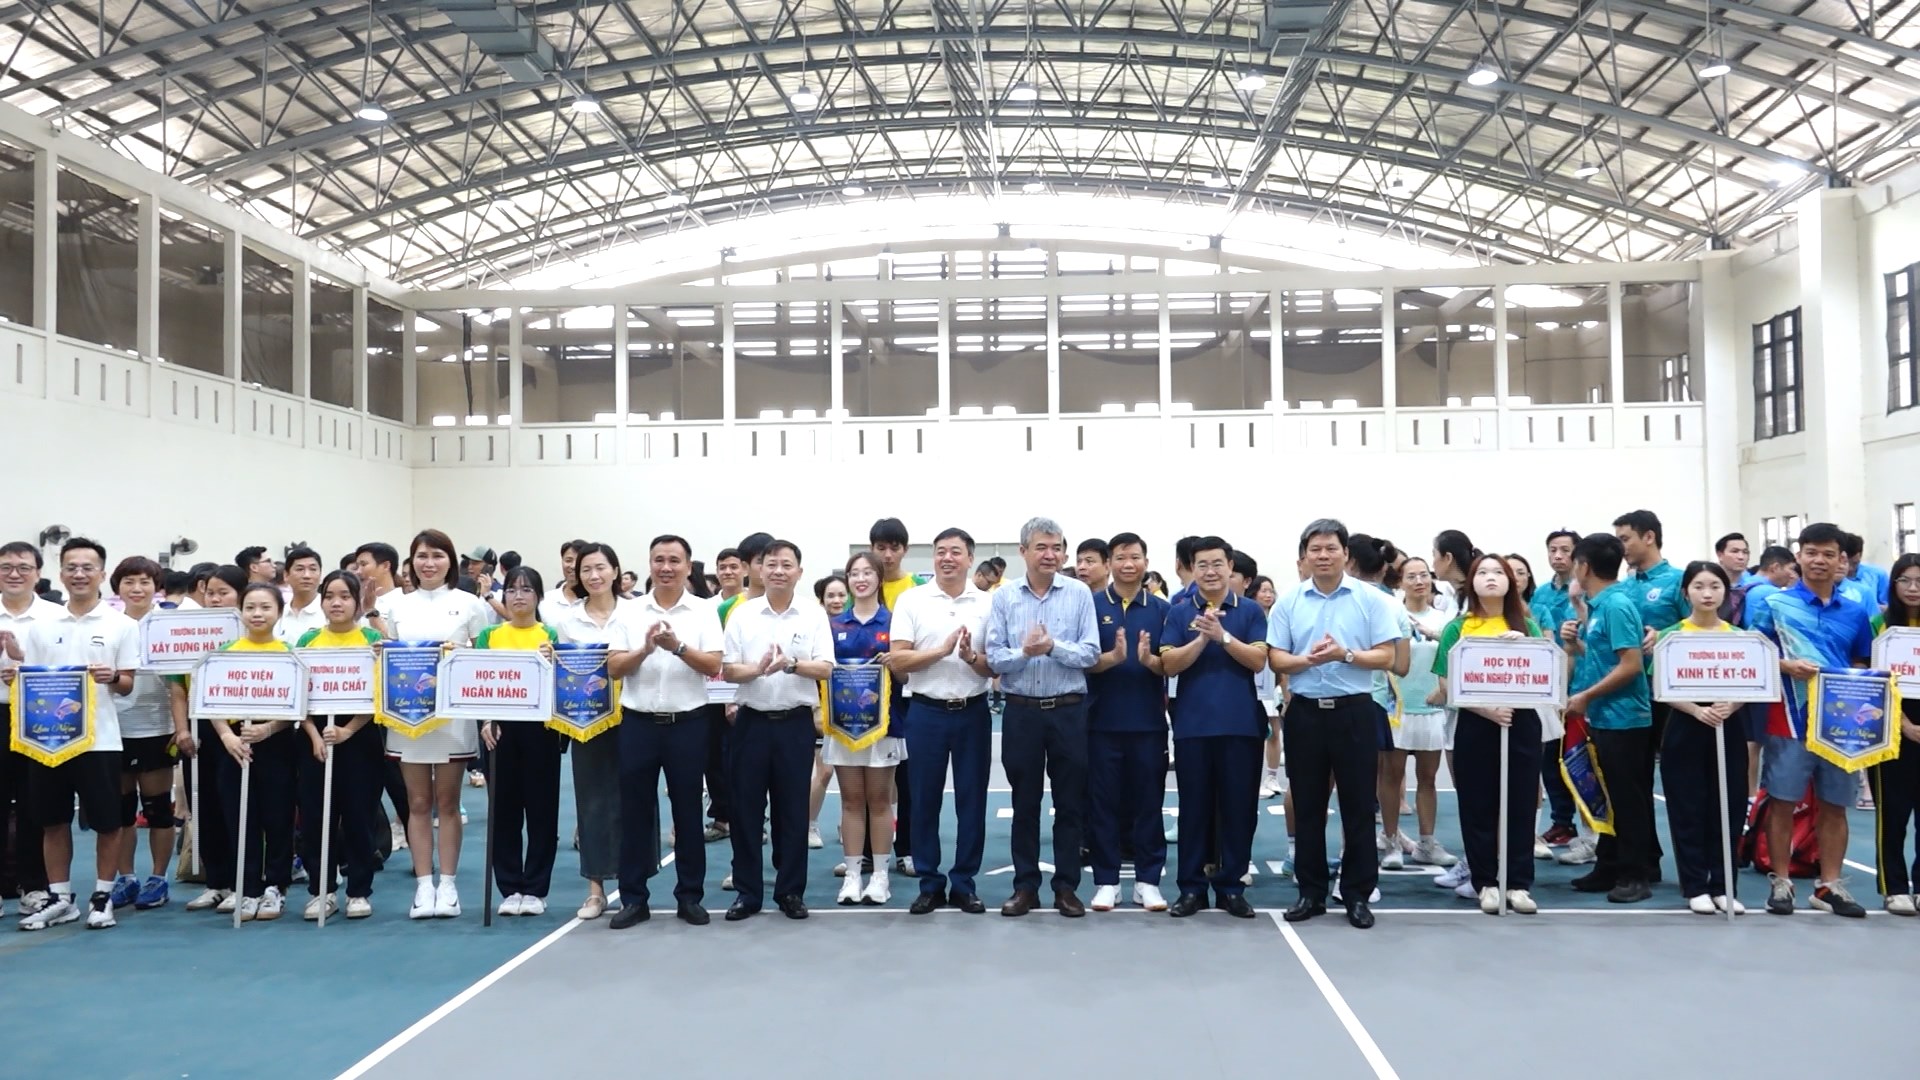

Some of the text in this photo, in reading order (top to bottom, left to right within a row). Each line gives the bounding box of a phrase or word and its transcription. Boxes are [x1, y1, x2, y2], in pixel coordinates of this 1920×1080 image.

[151, 640, 170, 653] XÂY
[173, 641, 200, 655] DỰNG
[1483, 656, 1531, 670] HỌC VIỆN
[228, 669, 274, 682] HỌC VIỆN
[475, 668, 521, 683] HỌC VIỆN
[1464, 670, 1549, 687] NÔNG NGHIỆP VIỆT NAM
[1677, 664, 1757, 679] KINH TẾ KT-CN
[209, 684, 291, 700] KỸ THUẬT QUÂN SỰ
[323, 681, 339, 694] ĐỊA
[342, 677, 367, 692] CHẤT
[461, 684, 528, 699] NGÂN HÀNG
